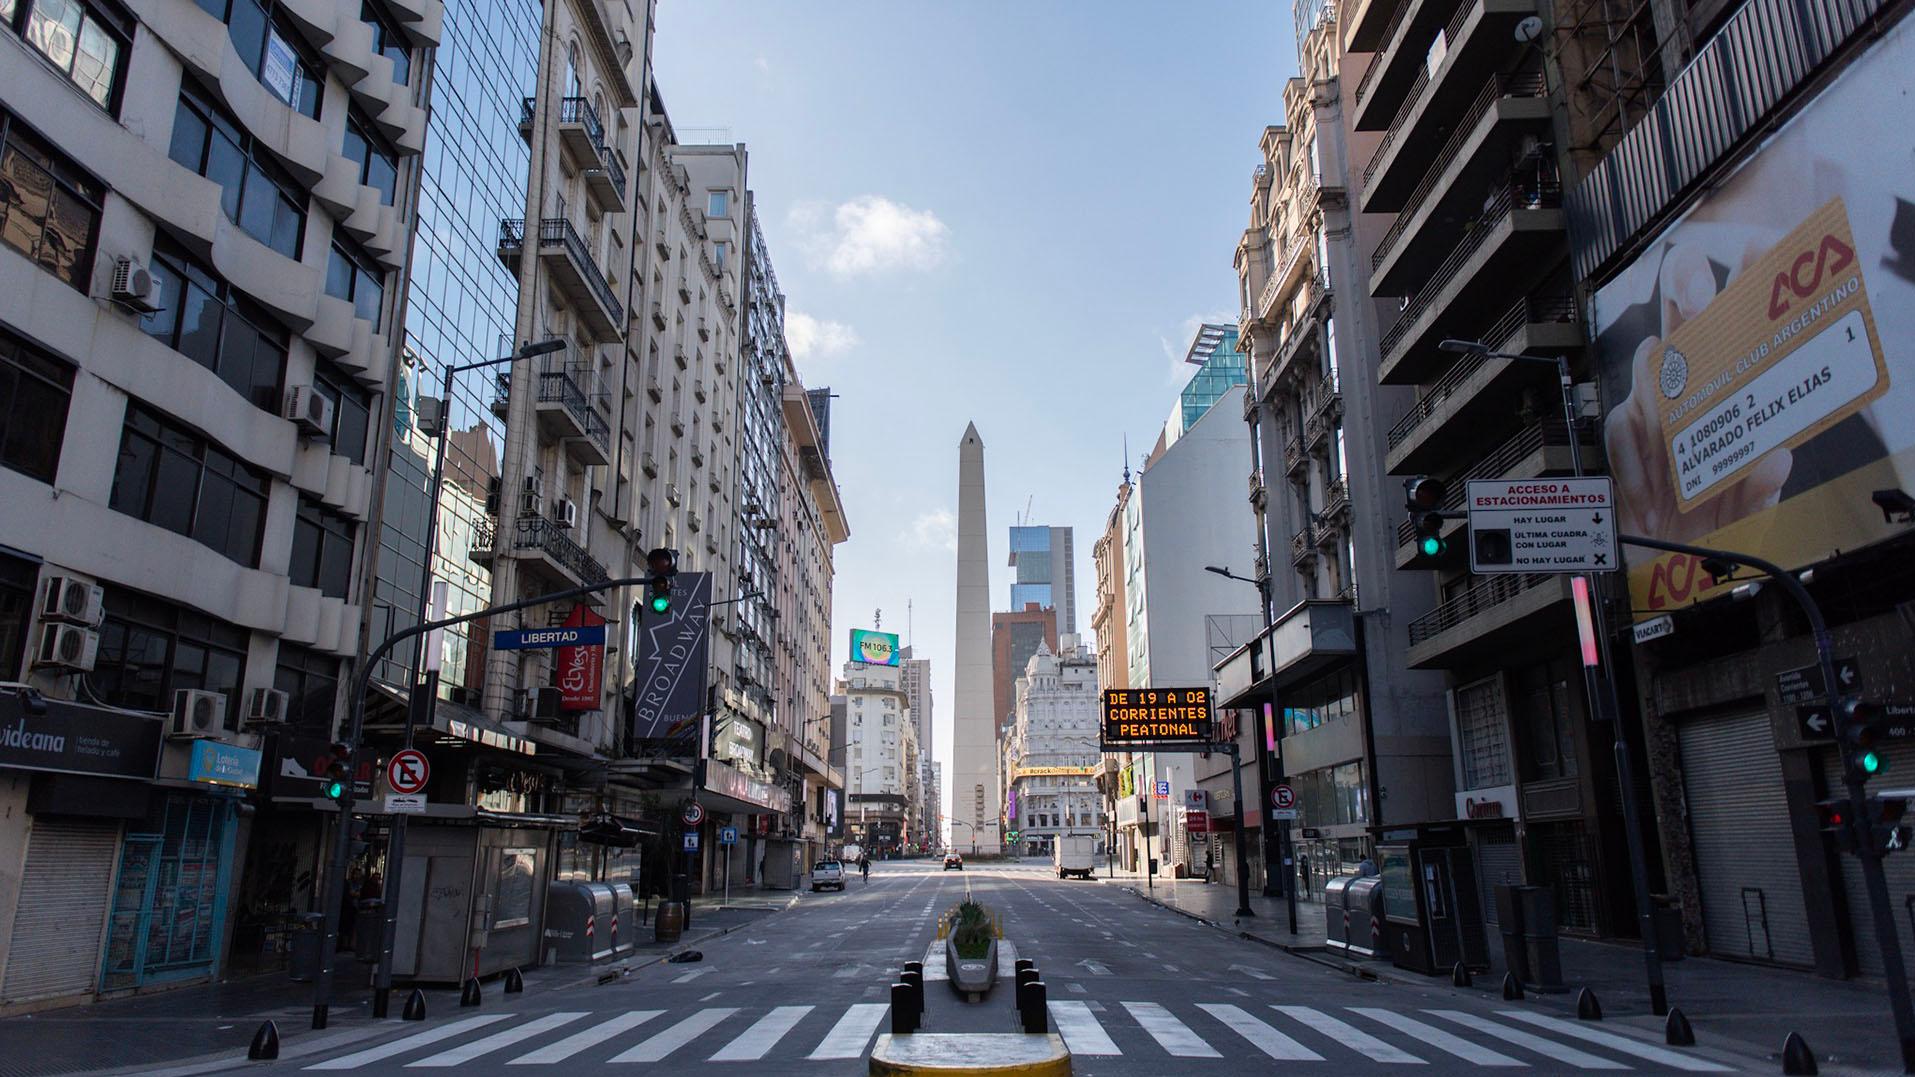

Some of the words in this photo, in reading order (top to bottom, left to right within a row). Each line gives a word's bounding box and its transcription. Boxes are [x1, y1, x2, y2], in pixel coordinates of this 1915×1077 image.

[1768, 234, 1855, 321] ACA
[1845, 326, 1856, 343] 1
[1668, 370, 1733, 426] AUTOMOVIL
[1735, 343, 1769, 375] CLUB
[1772, 276, 1859, 349] ARGENTINO
[1678, 443, 1686, 456] 4
[1690, 405, 1741, 449] 1080906
[1746, 394, 1757, 409] 2
[1681, 425, 1744, 475] ALVARADO
[1747, 396, 1786, 433] FELIX
[1788, 366, 1832, 406] ELIAS
[1686, 475, 1702, 492] DNI
[1711, 441, 1755, 476] 99999997
[1508, 484, 1557, 495] ACCESO
[1562, 484, 1570, 493] A
[1476, 494, 1606, 506] ESTACIONAMIENTOS
[1514, 516, 1532, 524] HAY
[1550, 530, 1588, 538] CUADRA
[1554, 556, 1585, 564] LUGAR
[521, 631, 578, 644] LIBERTAD
[1636, 624, 1663, 639] VIACART
[859, 641, 872, 650] FM
[873, 643, 893, 653] 106.3
[638, 599, 706, 722] BROADWAY
[1109, 693, 1128, 705] DE
[1139, 692, 1157, 704] 19
[1167, 692, 1177, 704] A
[1186, 691, 1206, 703] 02
[1110, 707, 1207, 721] CORRIENTES
[1120, 723, 1198, 736] PEATONAL
